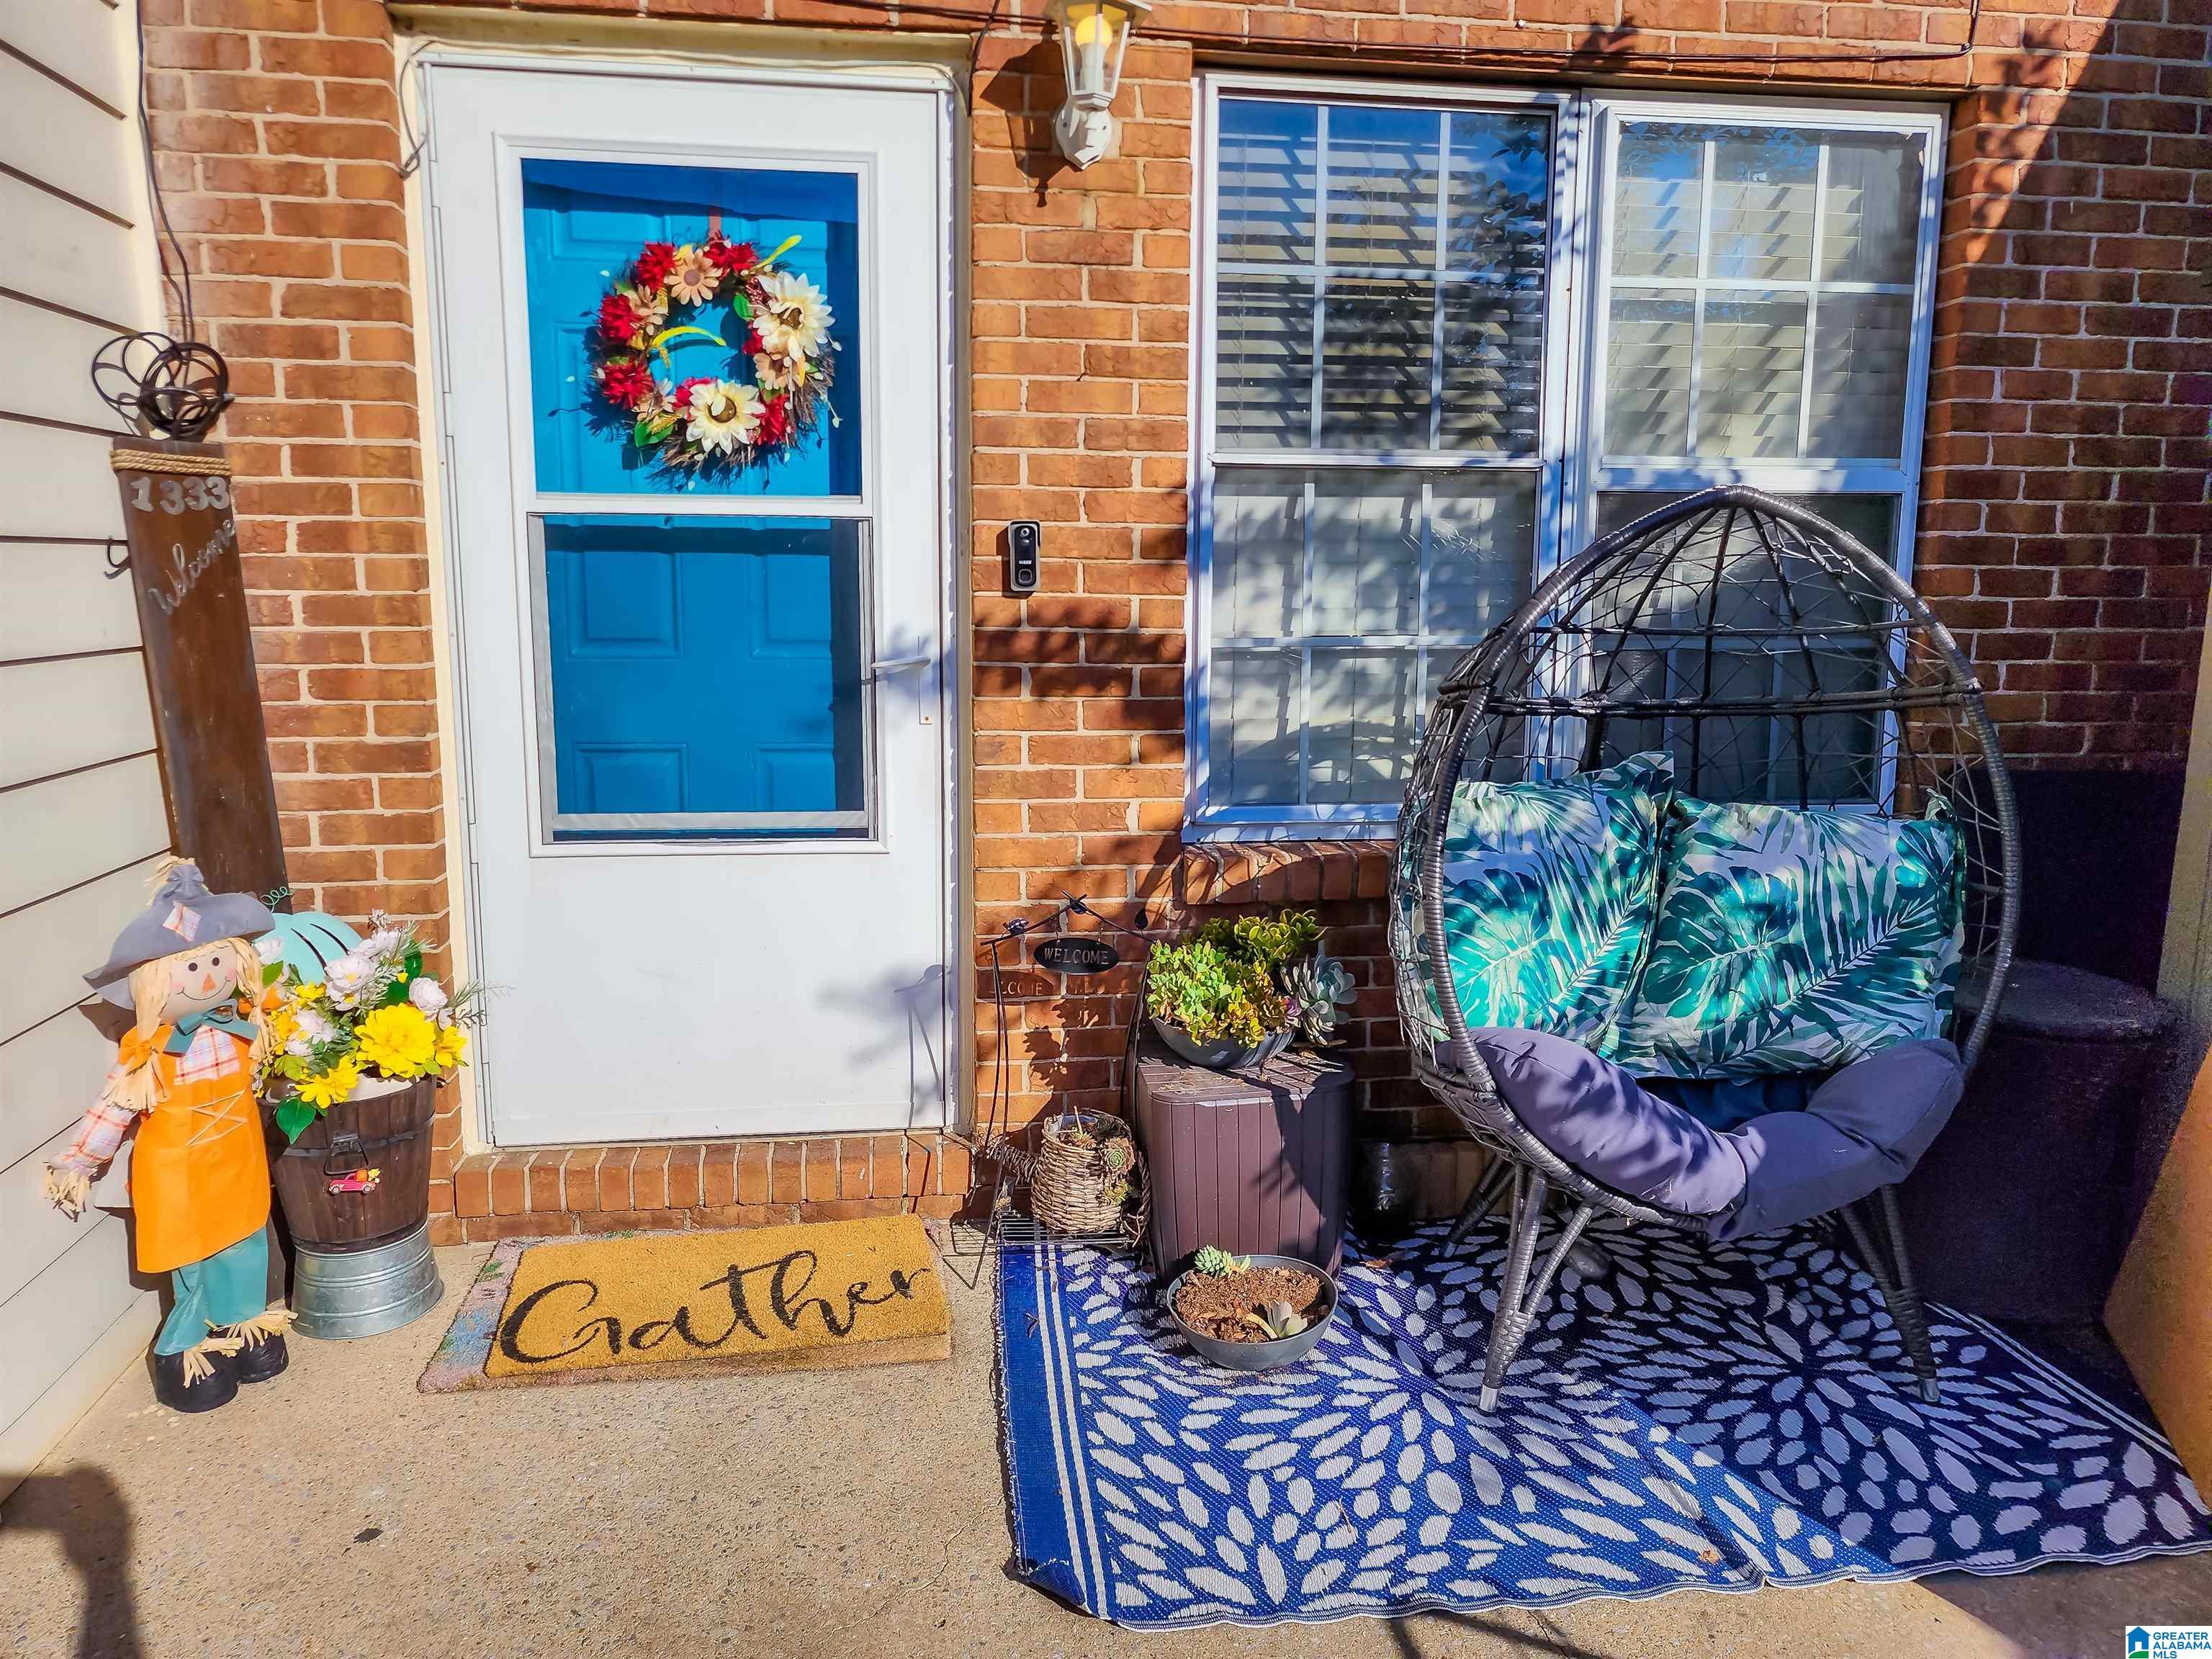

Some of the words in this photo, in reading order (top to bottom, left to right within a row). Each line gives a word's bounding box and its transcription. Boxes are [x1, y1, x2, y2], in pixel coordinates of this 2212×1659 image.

[130, 476, 230, 515] 1333
[1044, 948, 1110, 966] WELCOME
[500, 1250, 931, 1363] Gather
